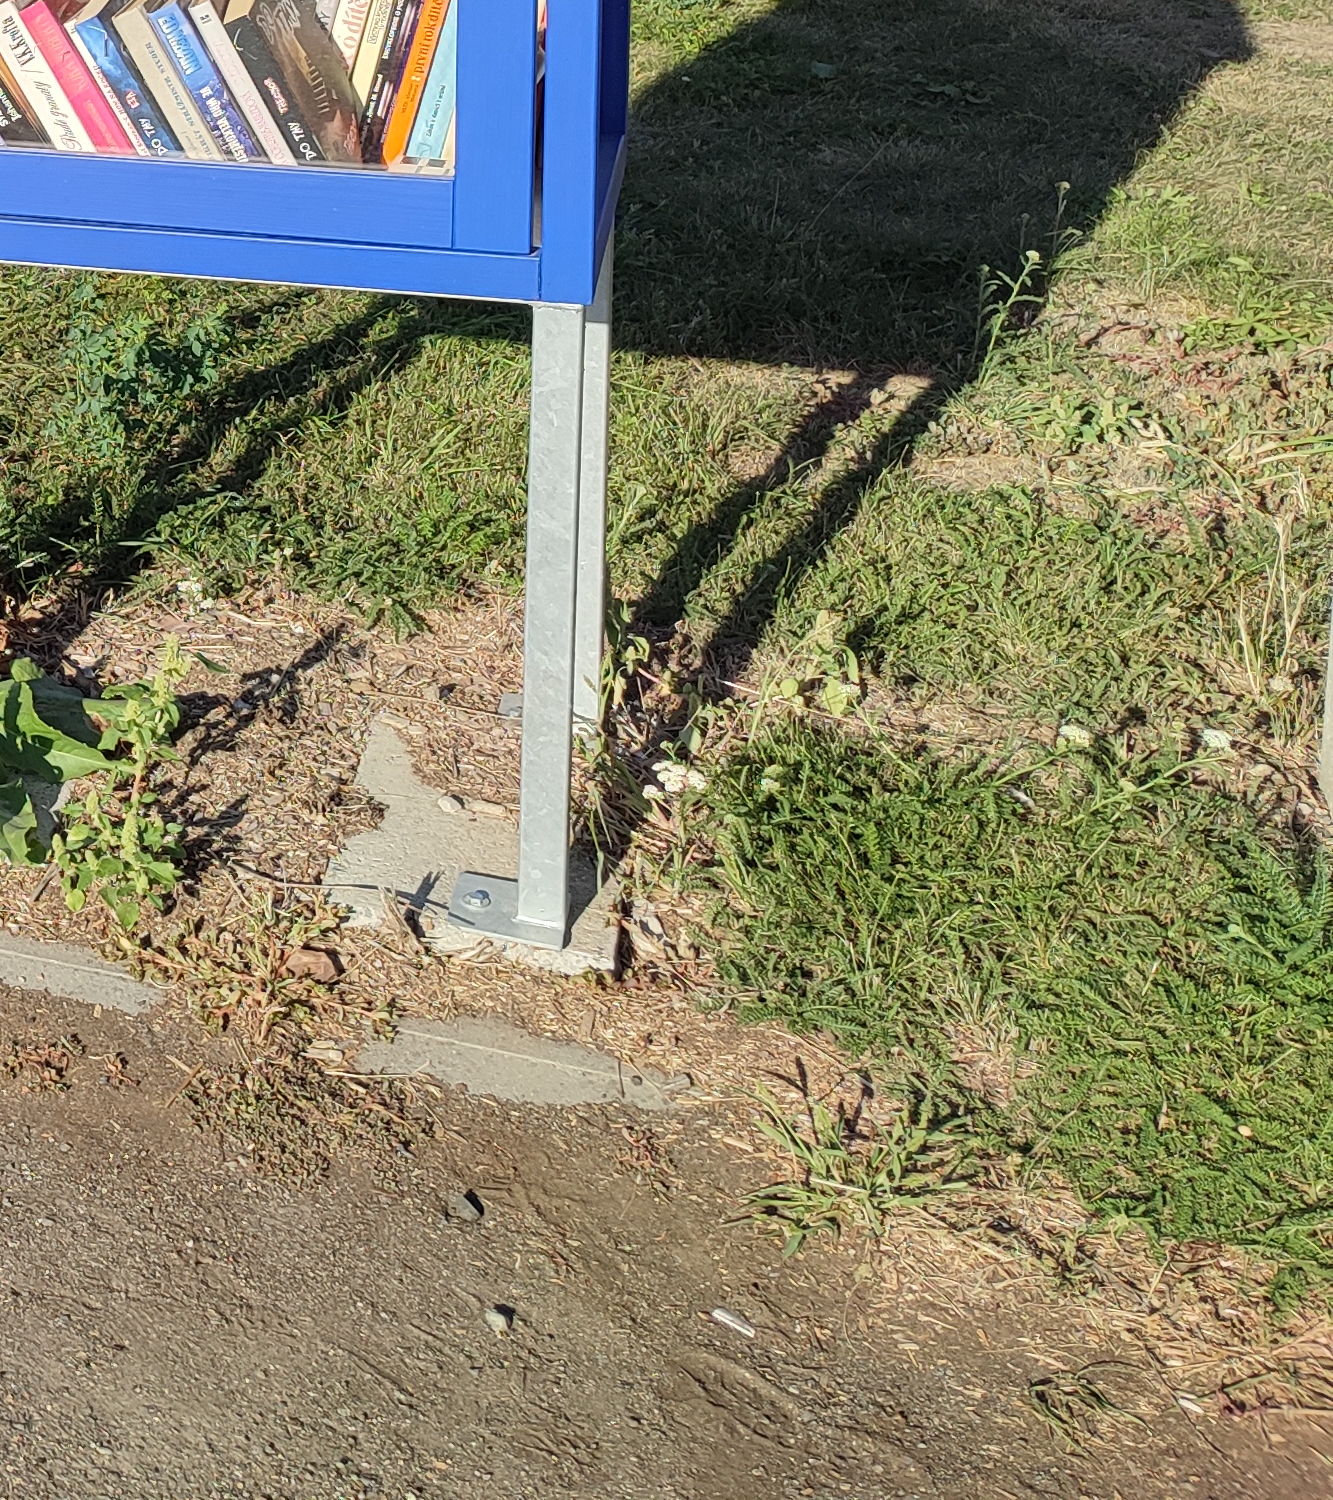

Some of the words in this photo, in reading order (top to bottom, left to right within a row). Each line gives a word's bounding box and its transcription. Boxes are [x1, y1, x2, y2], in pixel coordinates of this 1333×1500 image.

[157, 12, 180, 34] ED
[420, 20, 436, 41] rok
[414, 42, 430, 75] první
[138, 117, 158, 139] TMY
[287, 120, 306, 142] TMY
[151, 136, 169, 156] DO
[299, 139, 317, 161] DO
